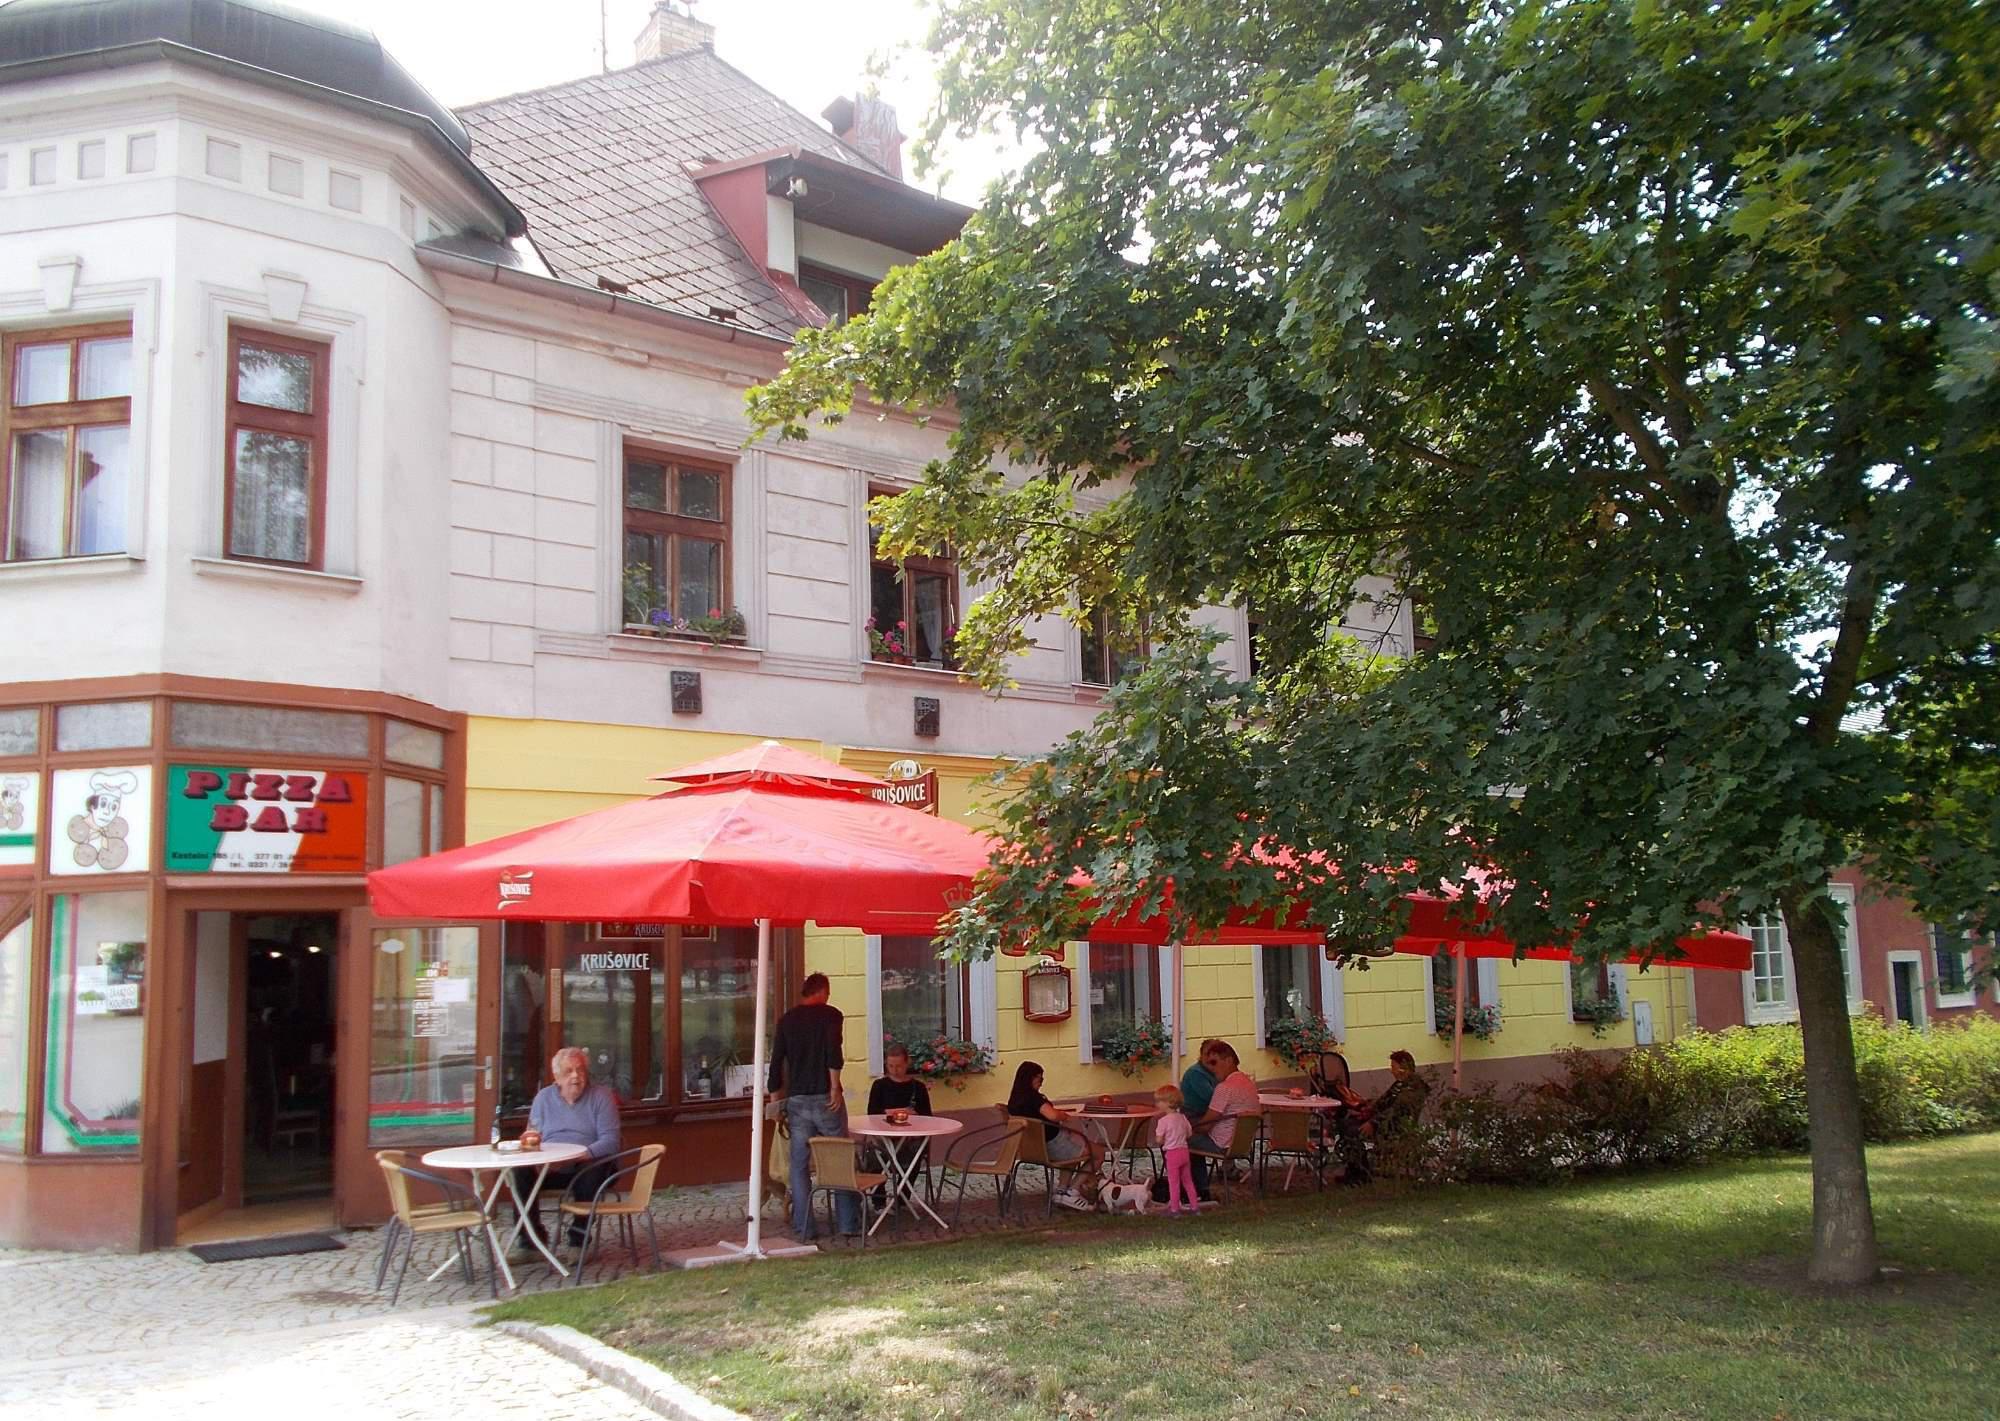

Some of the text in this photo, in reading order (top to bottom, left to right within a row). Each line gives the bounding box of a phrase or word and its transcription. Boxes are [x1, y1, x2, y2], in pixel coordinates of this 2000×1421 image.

[184, 771, 352, 802] PIZZA
[209, 804, 329, 833] BAR
[581, 951, 650, 974] KRUŠOVICE
